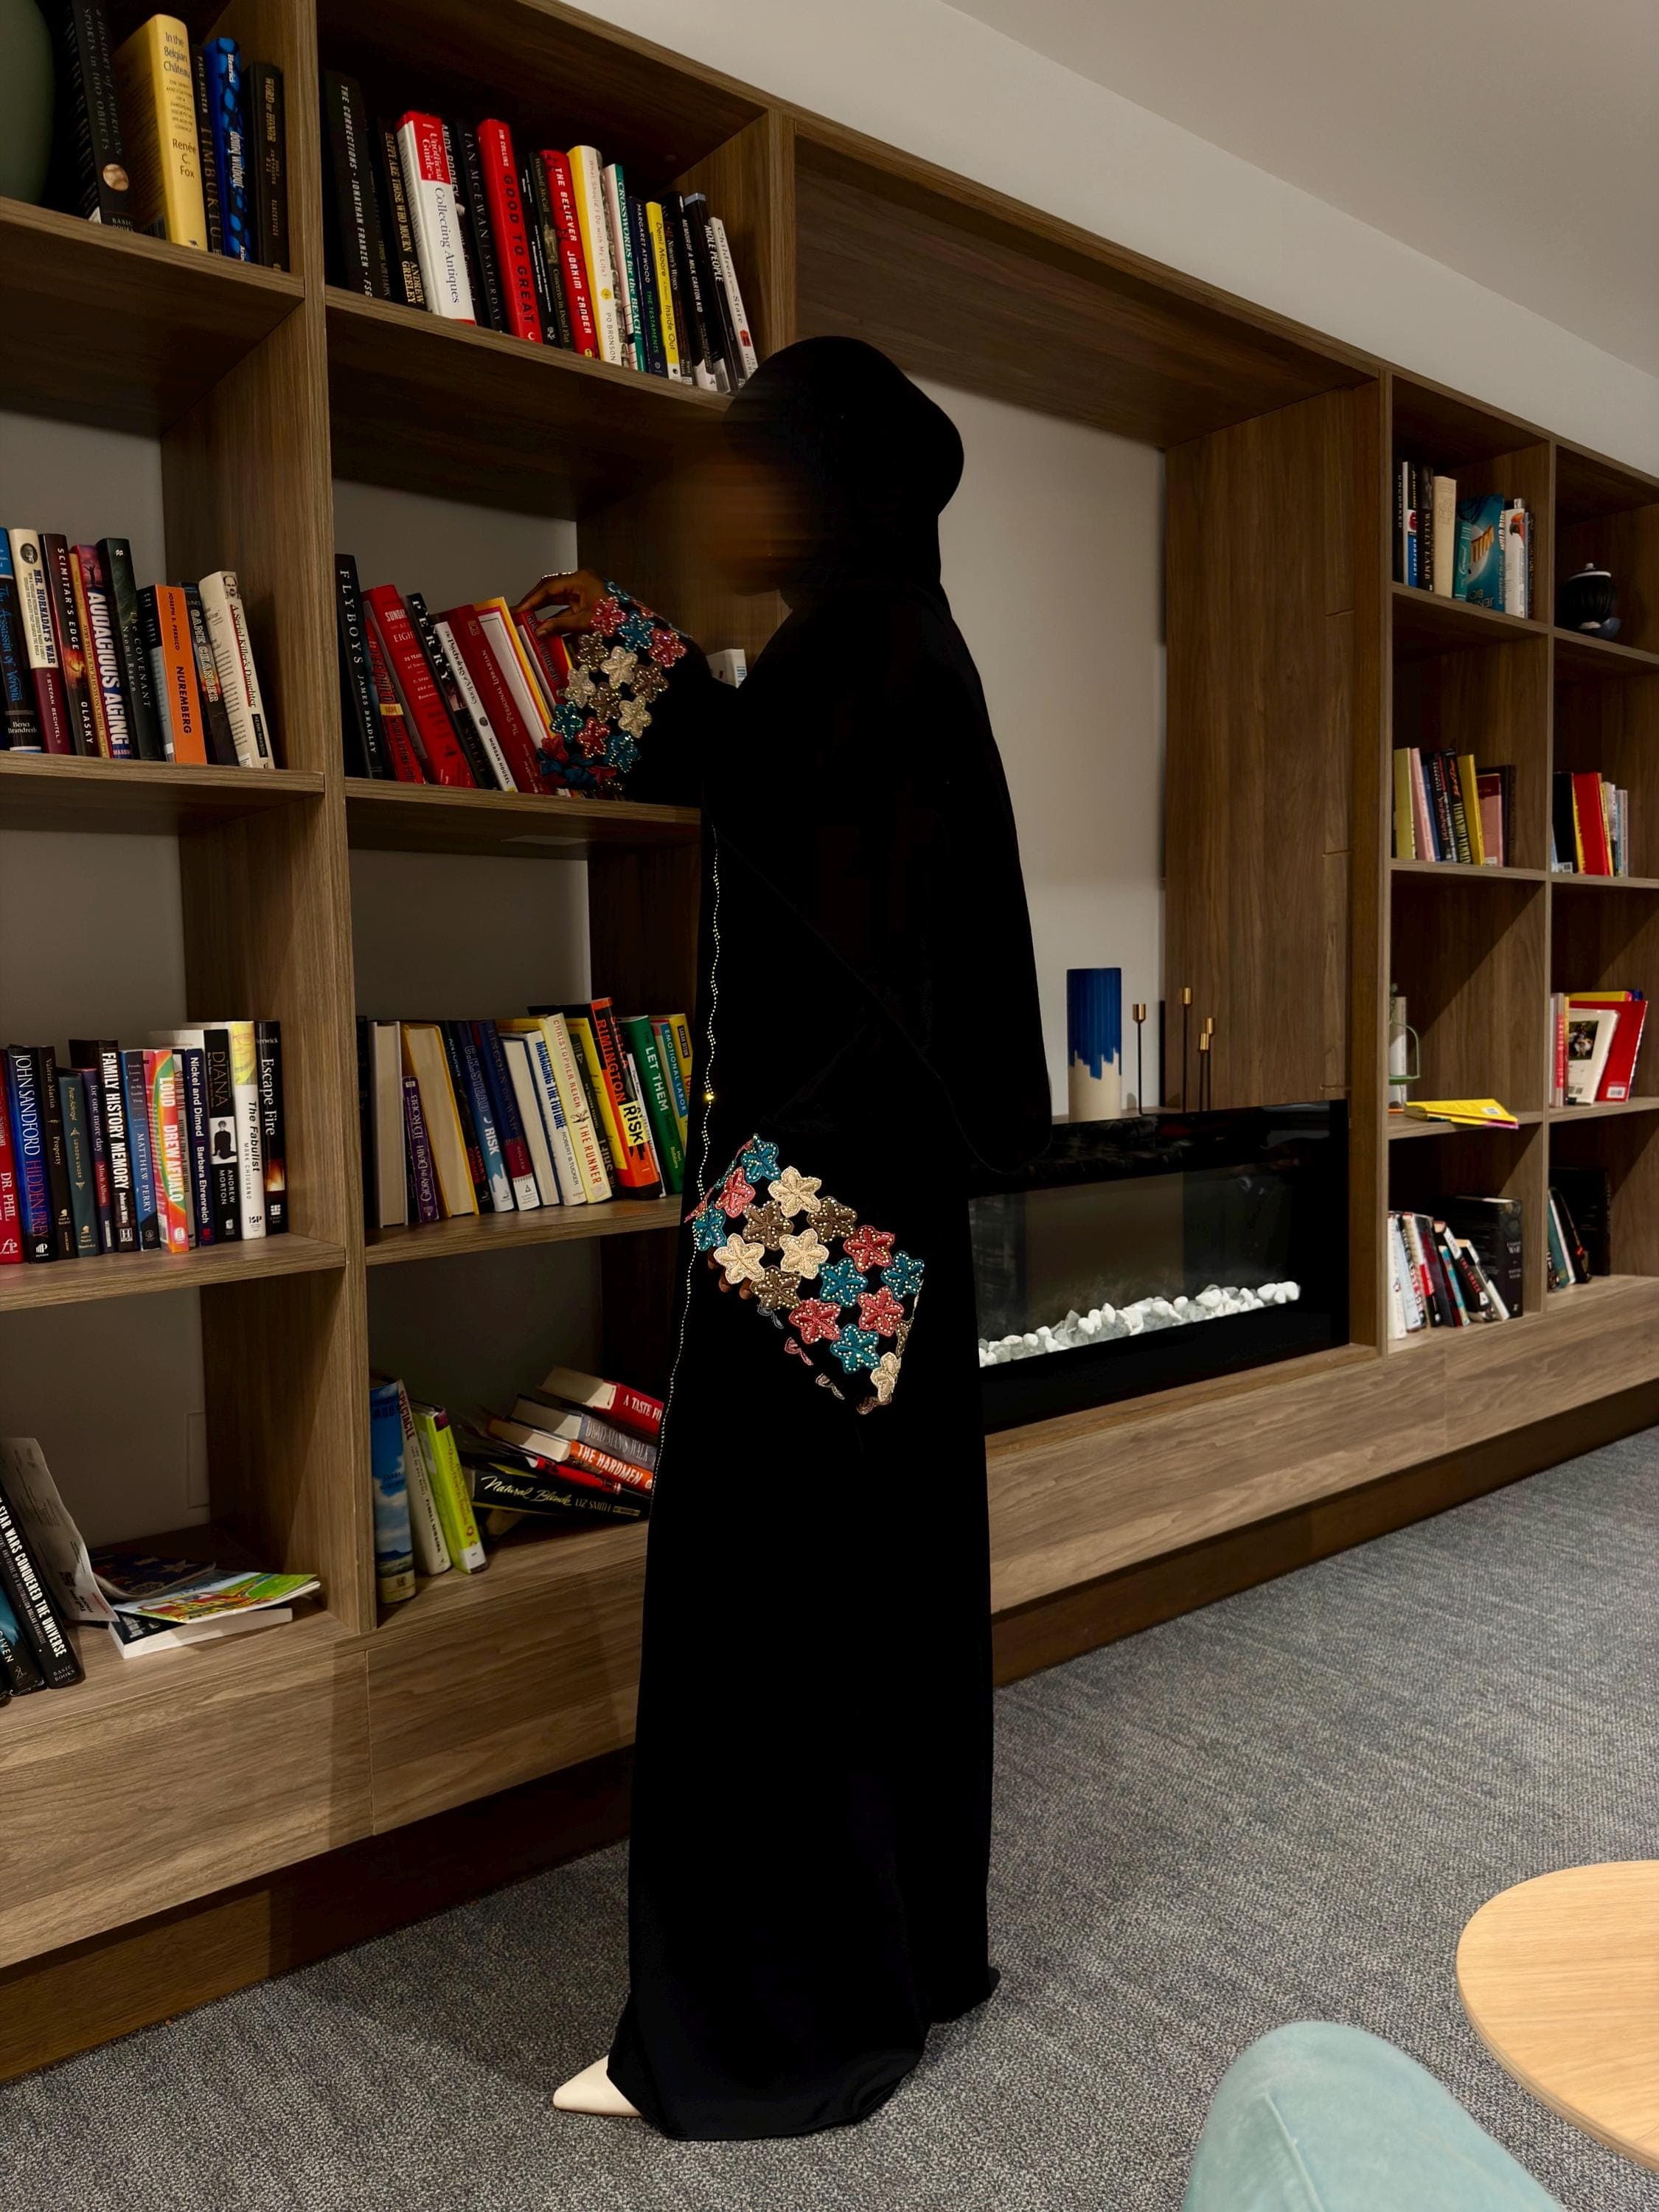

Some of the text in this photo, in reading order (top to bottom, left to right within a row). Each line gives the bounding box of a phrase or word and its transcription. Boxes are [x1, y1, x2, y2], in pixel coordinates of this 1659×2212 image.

[164, 46, 187, 60] Belgian
[164, 60, 190, 77] Château
[341, 84, 350, 104] THE
[173, 139, 195, 153] Renée
[197, 56, 222, 240] PAUL AUSTER TIMBUKTU
[343, 105, 358, 169] CORRECTIONS
[463, 132, 476, 161] IAN
[500, 141, 510, 167] COLLINS
[180, 165, 195, 178] Fox
[231, 156, 246, 189] without
[385, 133, 412, 254] HAPPY ARE THOSE WHO MOURN
[504, 175, 518, 224] GOOD
[351, 179, 364, 224] JONATHAN
[681, 218, 692, 243] MEMOIR
[358, 227, 369, 267] FRANZEN
[435, 187, 460, 304] Collecting Antiques
[512, 233, 524, 256] TO
[555, 167, 591, 334] THE BELIEVER JOAKIM ZANDER
[618, 181, 642, 335] CROSSWORDS for the BEACH
[686, 243, 694, 252] OF
[688, 259, 697, 276] MILK
[704, 225, 723, 283] MOLE PEOPLE
[401, 260, 417, 304] GREELEY
[409, 261, 424, 304] ANDREW
[484, 254, 502, 322] SATURDAY
[516, 264, 536, 323] GREAT
[636, 203, 646, 248] MARGARET
[641, 248, 650, 284] ATWOOD
[647, 306, 659, 354] TESTAMENTS
[655, 222, 676, 350] Demi Moore Inside Out
[690, 276, 701, 301] CARTON
[695, 301, 703, 313] KID
[731, 296, 743, 324] State
[1423, 551, 1432, 580] LAMB
[34, 569, 55, 664] MR. HORNADAY'S WAR
[130, 611, 139, 631] The
[168, 592, 176, 616] JOSEPH
[173, 625, 181, 651] PERSICO
[412, 600, 451, 680] PERRY
[57, 548, 74, 616] SCIMITAR'S
[68, 621, 80, 650] EDGE
[80, 702, 94, 745] OLASKY
[88, 591, 119, 690] AUDACIOUS
[104, 691, 128, 745] AGING
[122, 625, 136, 692] Naomi Ragen
[133, 637, 151, 707] COVENANT
[190, 609, 218, 703] GAME CHANGER
[232, 605, 257, 708] A Serial Killer's Daughter
[339, 569, 376, 754] FLYBOYS JAMES BRADLEY
[46, 678, 60, 739] STEFAN BECHTEL
[176, 666, 192, 734] NUREMBERG
[489, 737, 510, 785] MORGAN HOUSEL
[102, 1052, 119, 1091] FAMILY
[212, 1051, 229, 1107] DIANA
[535, 1041, 566, 1130] MANAGING THE FUTURE
[597, 1019, 625, 1103] RIMINGTON
[645, 1046, 669, 1112] LET THEM
[664, 1029, 686, 1111] EMOTIONAL LABOR
[45, 1058, 62, 1166] Valerie Martin Property
[91, 1085, 103, 1152] for one more day
[105, 1093, 123, 1139] HISTORY
[258, 1058, 278, 1135] Escape Fire
[554, 1019, 602, 1185] CHRISTOPHER REICH THE RUNNER
[624, 1106, 644, 1143] RISK
[12, 1054, 48, 1239] JOHN SANDFORD HIDDEN PREY
[159, 1077, 184, 1203] LOUD DREW AFUALO
[190, 1057, 209, 1223] Nickel and Dimed Barbara Ehrenreich
[248, 1101, 261, 1172] The Fabulist
[670, 1147, 678, 1169] Robbins
[100, 1183, 108, 1203] Albom
[111, 1142, 129, 1190] MEMORY
[136, 1132, 150, 1212] MATTHEW PERRY
[218, 1169, 227, 1205] MORTON
[227, 1169, 235, 1203] ANDREW
[1, 1172, 15, 1221] DR. PHIL
[119, 1192, 127, 1211] Deborah
[398, 1391, 414, 1440] SPECTACLE
[578, 1444, 592, 1460] THE
[594, 1451, 642, 1483] HARDMEN
[0, 1505, 68, 1658] STAR WARS CONQUERED THE UNIVERSE
